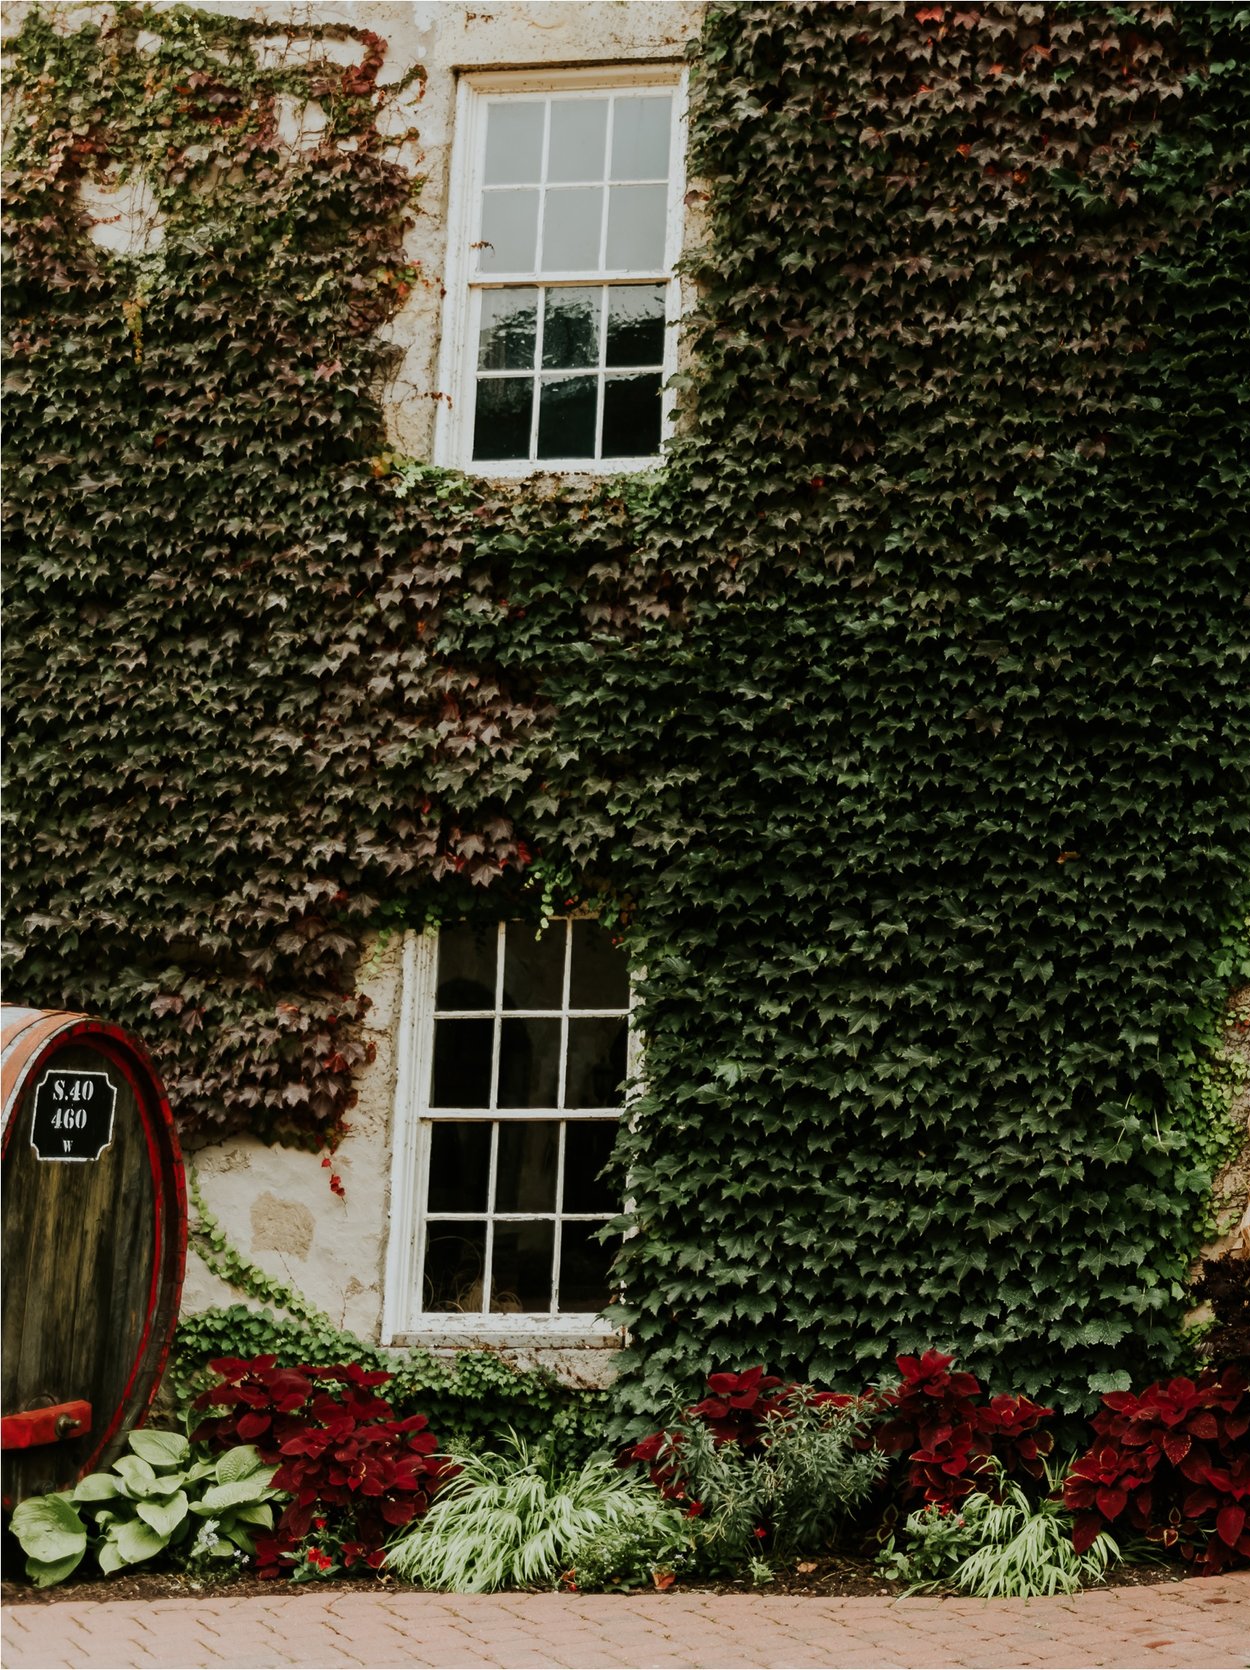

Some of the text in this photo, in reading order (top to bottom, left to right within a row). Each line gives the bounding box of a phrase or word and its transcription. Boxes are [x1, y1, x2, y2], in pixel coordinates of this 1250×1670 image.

[52, 1080, 94, 1101] S.40
[51, 1108, 87, 1129] 460
[62, 1140, 73, 1153] W
